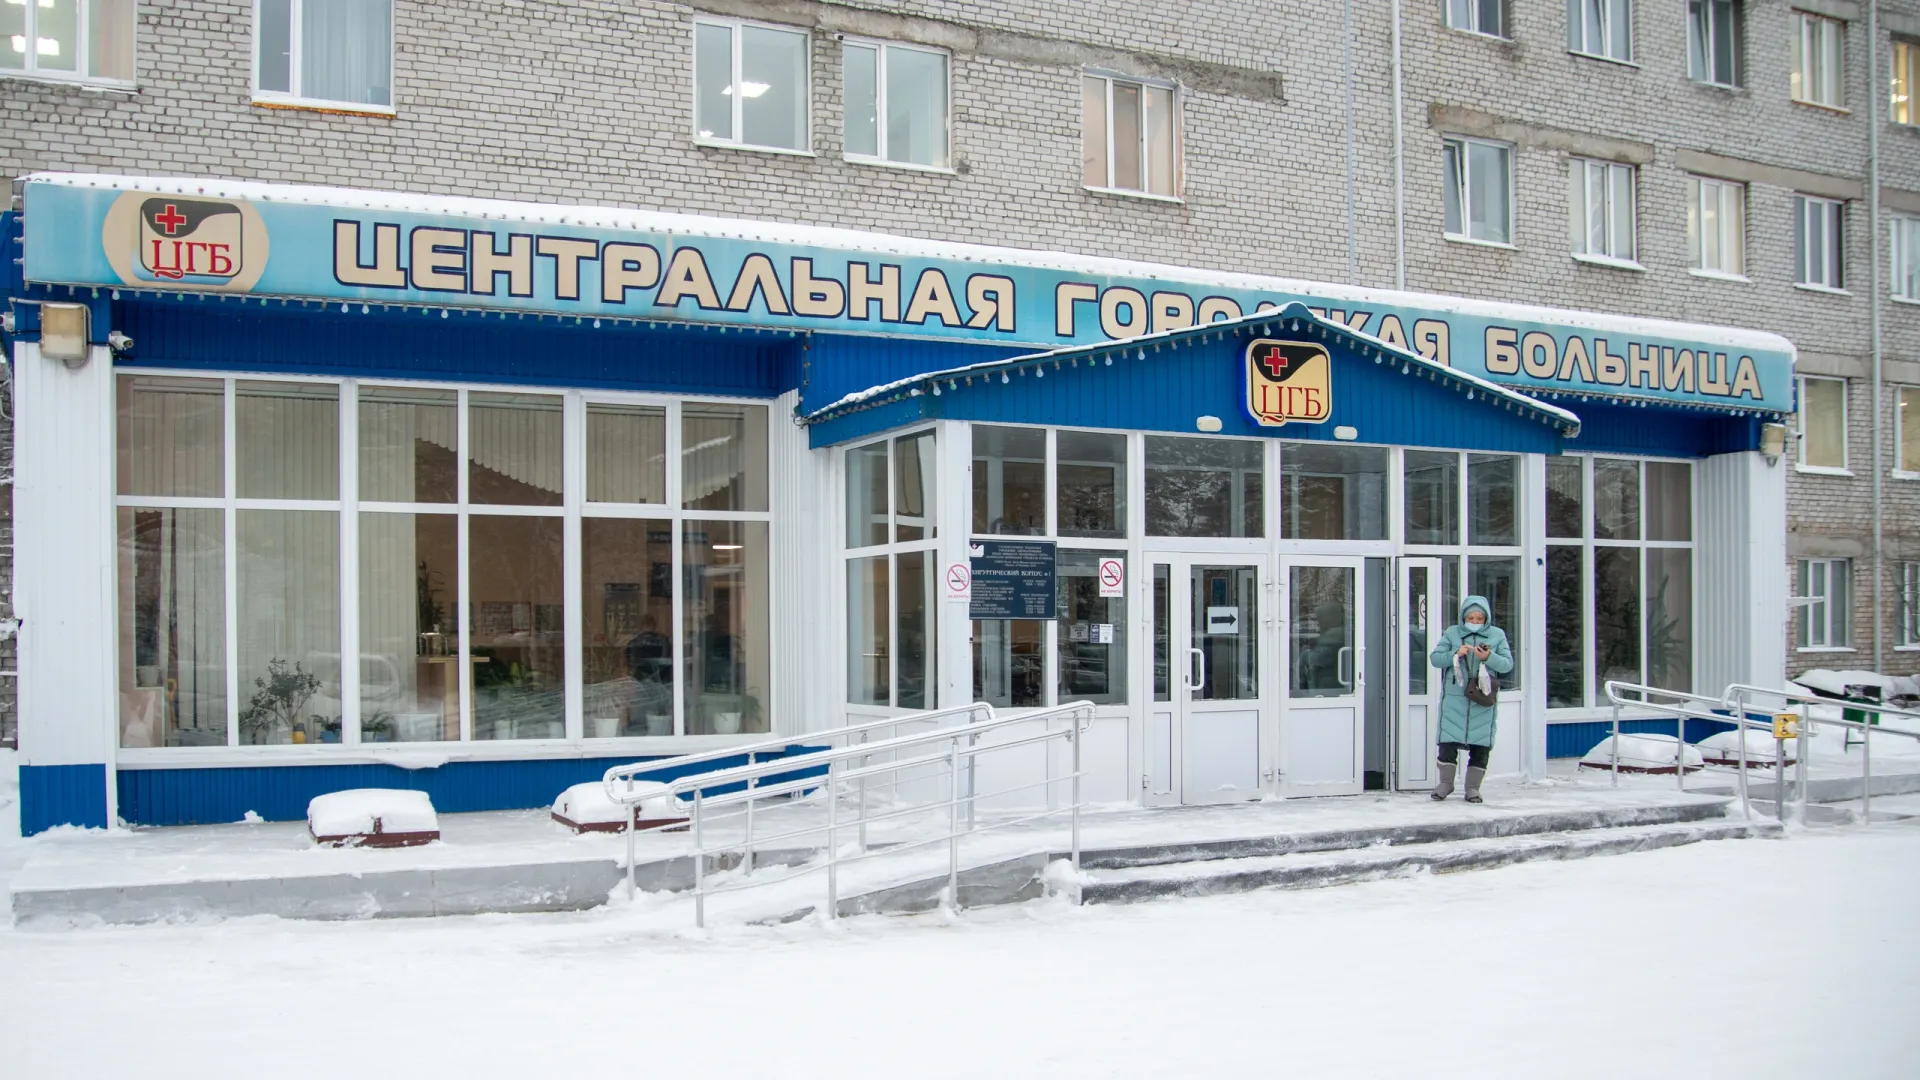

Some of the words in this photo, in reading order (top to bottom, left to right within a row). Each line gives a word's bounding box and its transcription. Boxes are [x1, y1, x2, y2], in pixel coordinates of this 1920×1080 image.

[151, 238, 233, 280] ЦГБ
[333, 218, 1017, 334] ЦЕНТРАЛЬНАЯ
[1055, 281, 1451, 367] ГОРАЯ
[1483, 324, 1764, 401] БОЛЬНИЦА
[1259, 382, 1323, 425] ЦГБ
